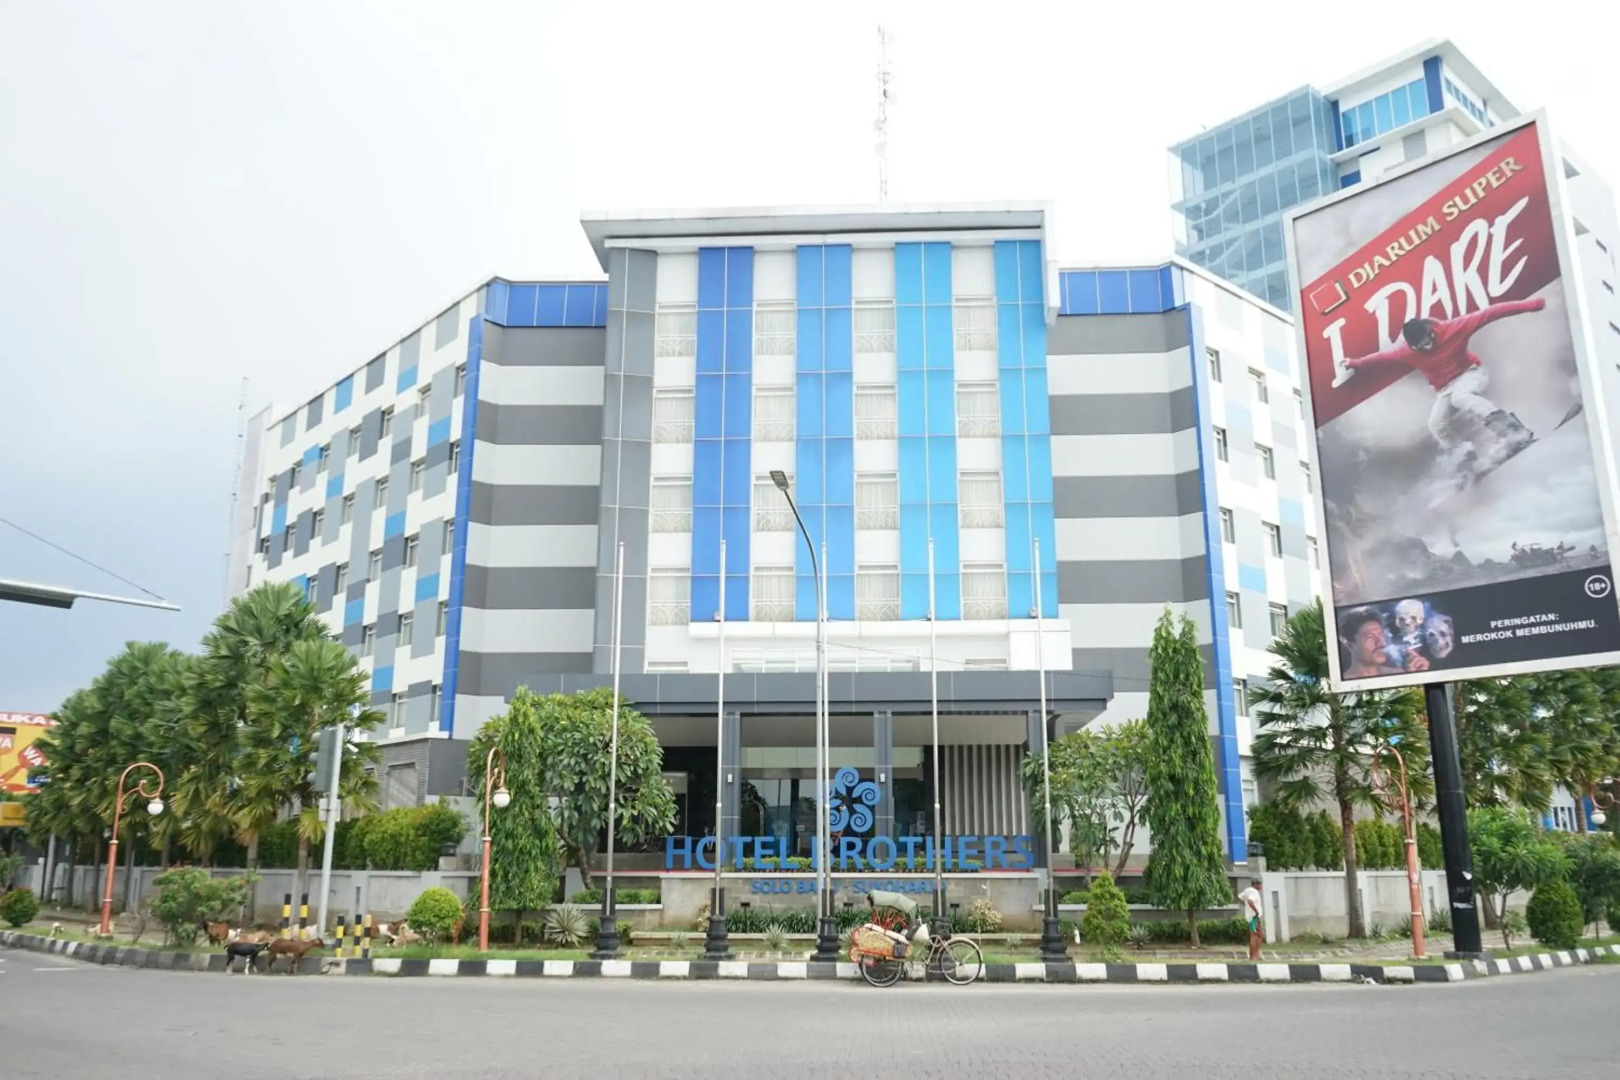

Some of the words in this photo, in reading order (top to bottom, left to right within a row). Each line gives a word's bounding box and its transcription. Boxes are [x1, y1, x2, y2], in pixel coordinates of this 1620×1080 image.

[1348, 215, 1442, 289] DJARUM
[1441, 156, 1524, 222] SUPER
[1323, 317, 1355, 389] I
[1364, 196, 1529, 352] DARE
[1461, 630, 1513, 644] MEROKOK
[1516, 619, 1598, 637] MEMBUNUHMU.
[1490, 613, 1559, 629] PERINGATAN:
[0, 712, 46, 727] UKA
[665, 835, 799, 870] HOTEL
[751, 879, 793, 894] SOLO
